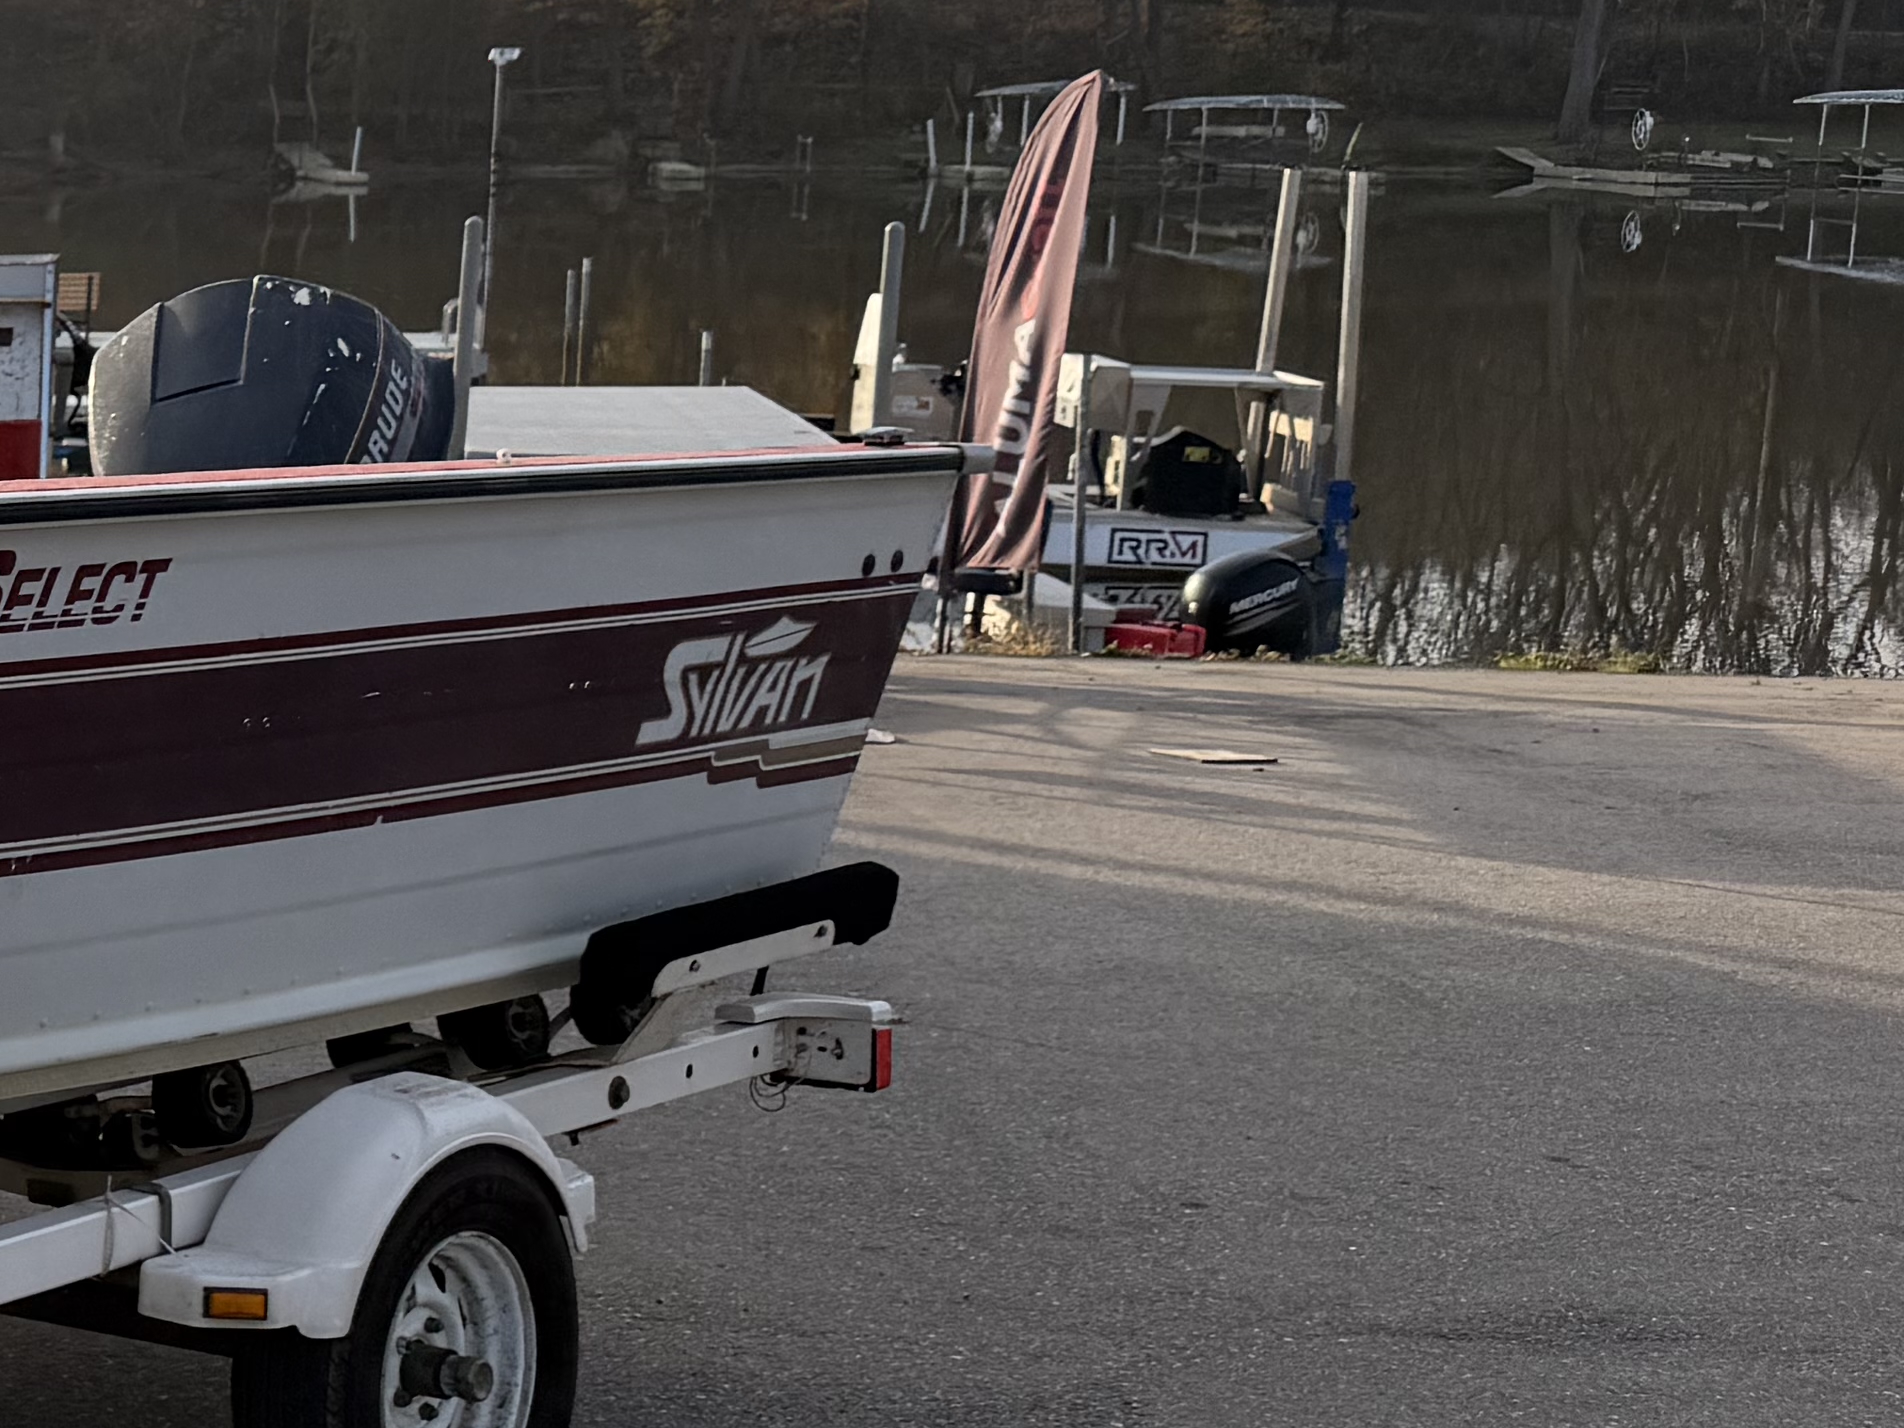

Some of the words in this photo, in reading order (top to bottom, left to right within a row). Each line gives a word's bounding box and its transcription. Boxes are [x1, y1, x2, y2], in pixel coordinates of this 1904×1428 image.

[359, 358, 409, 464] RUDE
[1117, 530, 1200, 562] RRM
[1228, 577, 1300, 615] MERCURY
